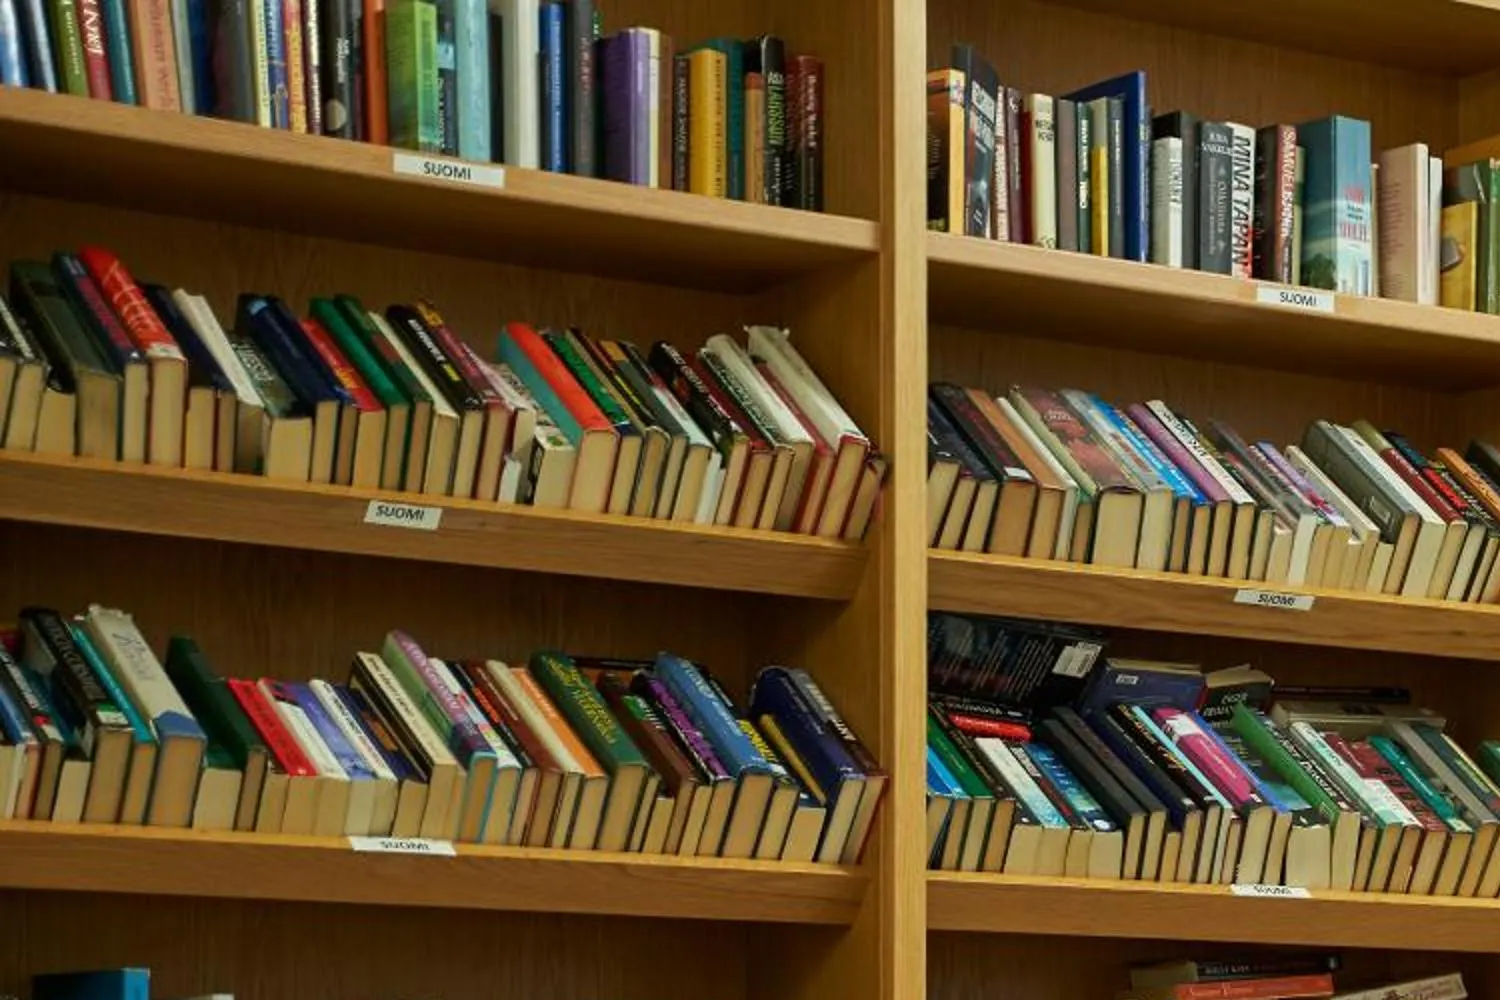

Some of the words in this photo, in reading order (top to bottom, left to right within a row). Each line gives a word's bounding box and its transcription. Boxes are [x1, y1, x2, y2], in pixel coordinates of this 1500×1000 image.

[423, 161, 471, 181] SUOMI
[1232, 135, 1251, 189] MINA
[1232, 198, 1252, 267] TAPAN
[1280, 291, 1317, 306] SUOMI
[376, 504, 425, 522] SUOMI
[1257, 593, 1294, 606] SUOMI
